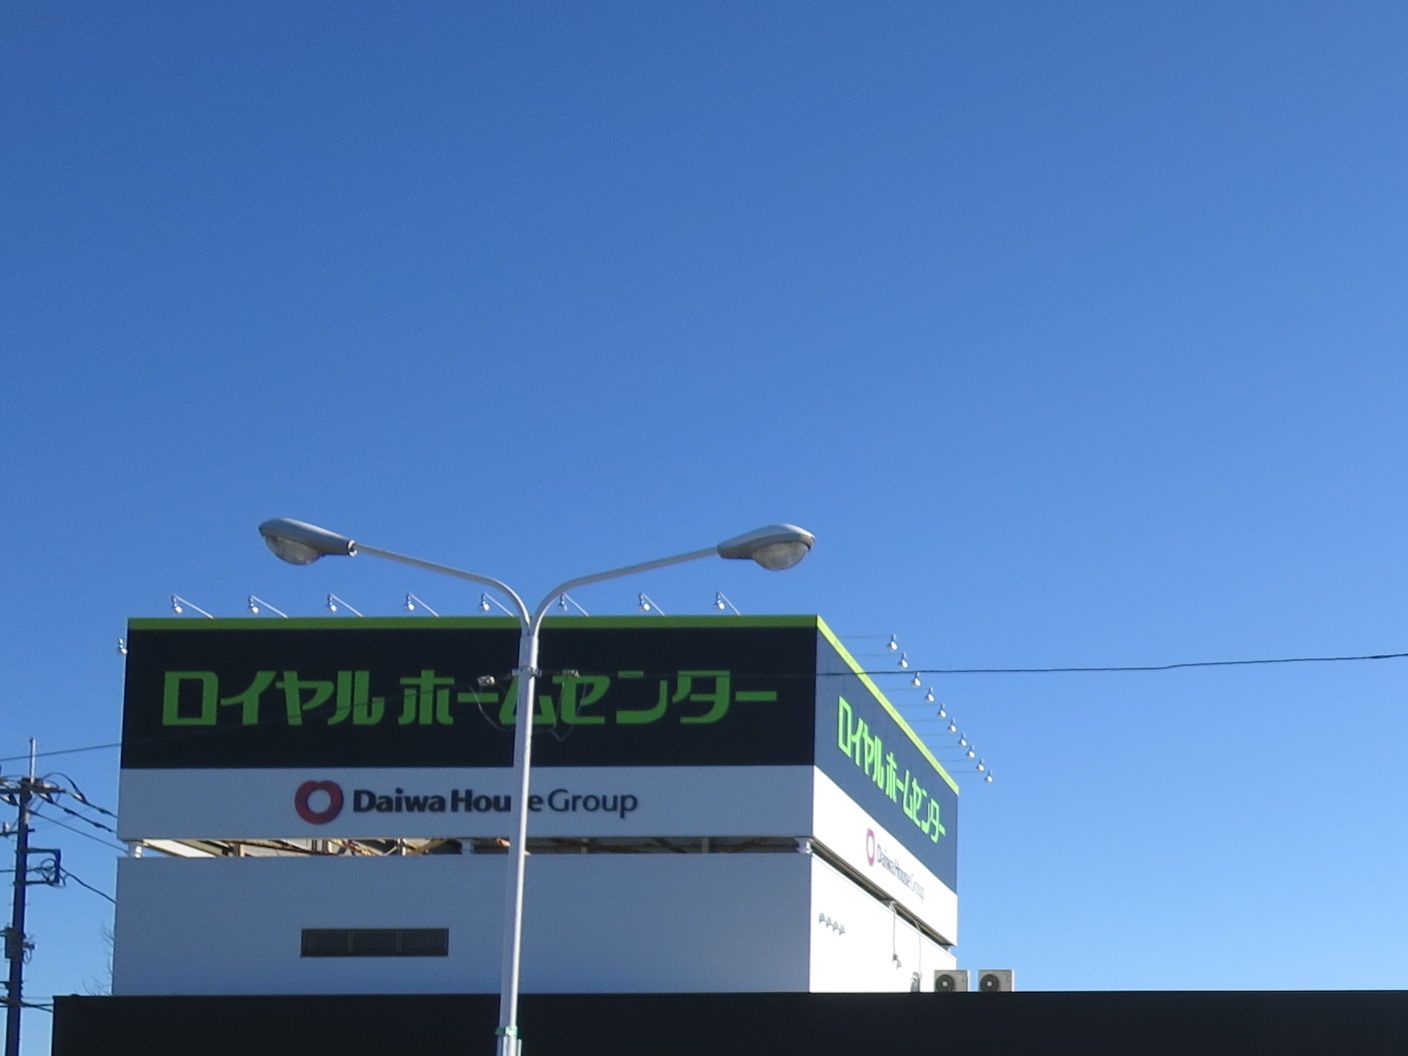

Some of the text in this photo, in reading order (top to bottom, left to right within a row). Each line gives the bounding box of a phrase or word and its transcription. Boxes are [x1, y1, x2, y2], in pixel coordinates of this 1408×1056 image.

[353, 787, 638, 818] Daiwa Houe Group
